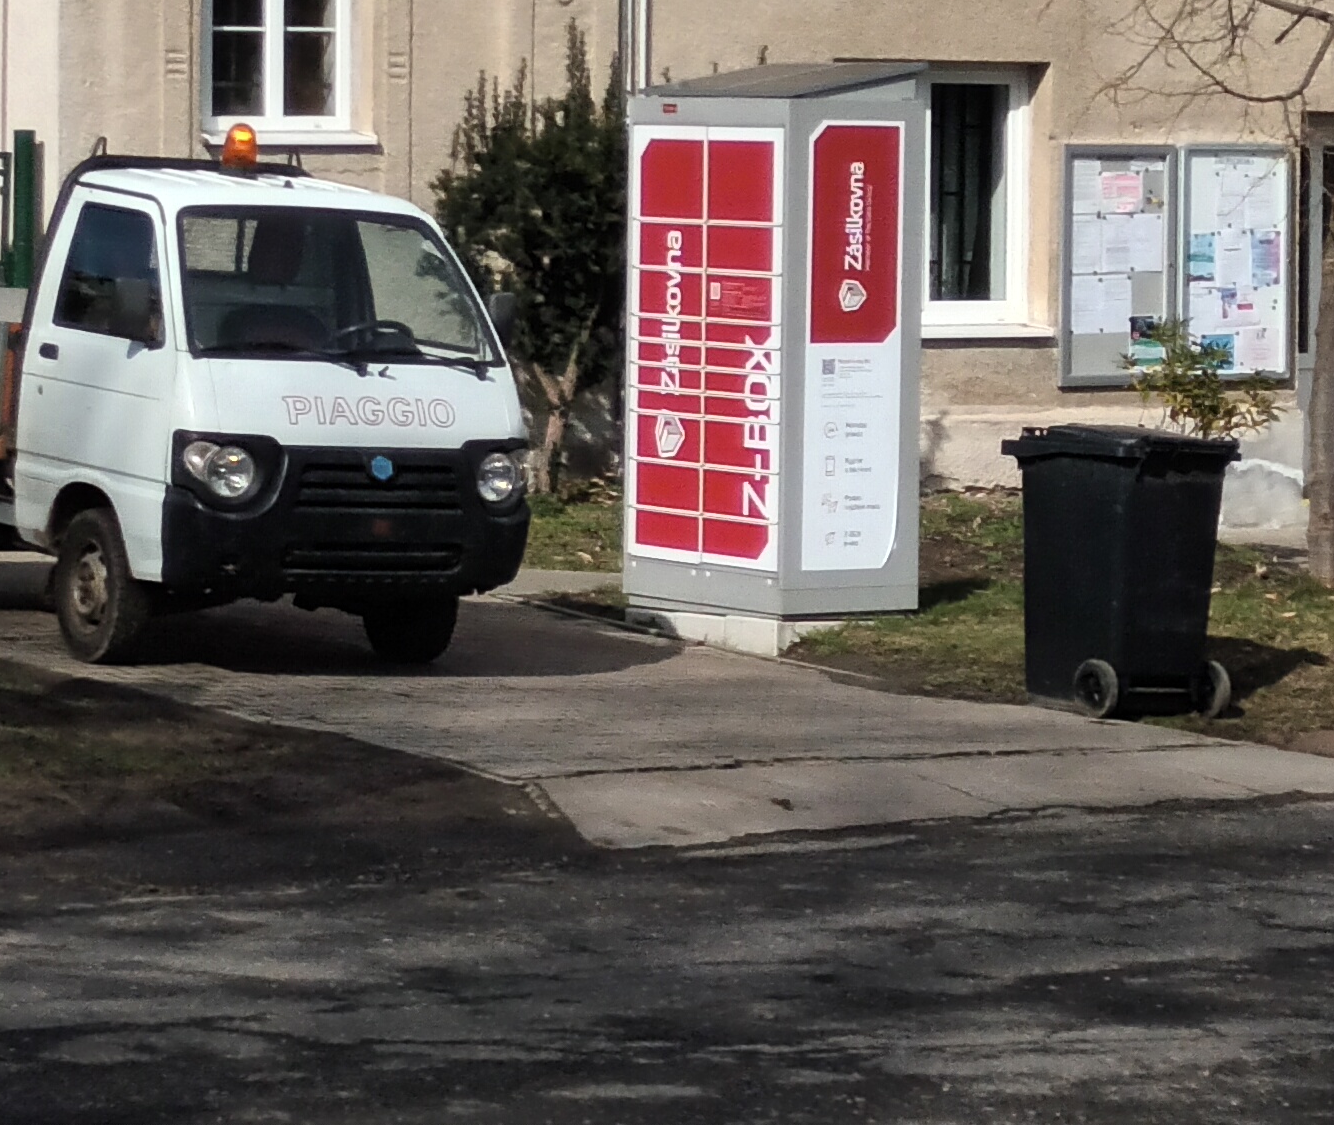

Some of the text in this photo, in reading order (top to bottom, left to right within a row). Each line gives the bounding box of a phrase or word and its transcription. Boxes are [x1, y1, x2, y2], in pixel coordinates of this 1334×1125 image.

[844, 162, 865, 271] Zásilkovna
[659, 230, 683, 395] Zásilkovna
[282, 396, 455, 428] PIAGGIO
[743, 335, 772, 520] Z-BOX
